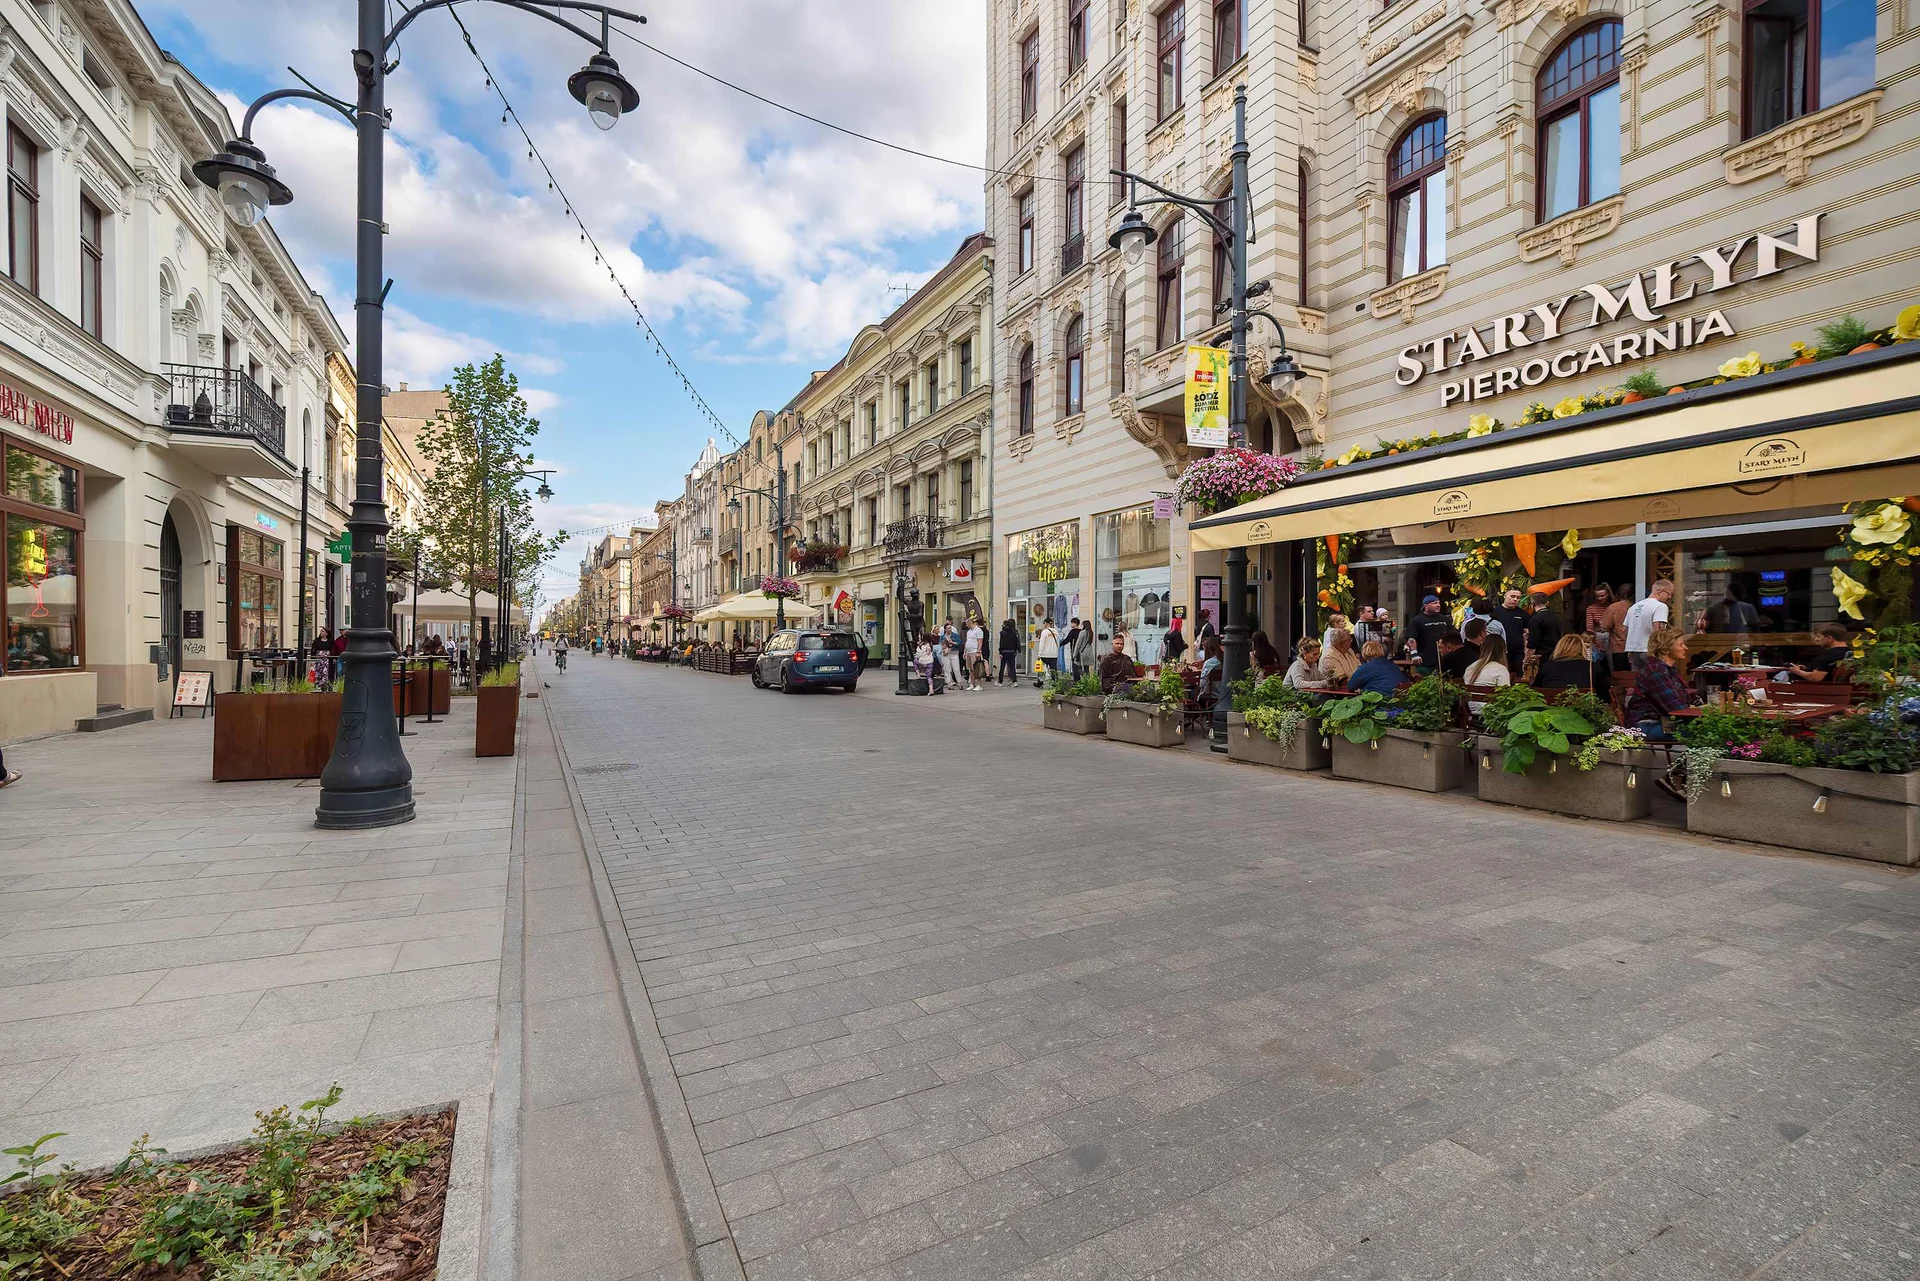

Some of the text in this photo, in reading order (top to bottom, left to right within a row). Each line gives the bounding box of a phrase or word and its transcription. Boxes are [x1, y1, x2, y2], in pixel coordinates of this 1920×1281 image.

[1395, 213, 1828, 388] STARY MŁYN
[1440, 309, 1737, 408] PIEROGARNIA
[1194, 389, 1219, 402] ŁÓDŹ
[1194, 399, 1219, 408] SUMMER
[1194, 405, 1220, 413] FESTIVAL
[1745, 460, 1771, 469] STARY
[1032, 540, 1073, 565] second
[1038, 563, 1058, 584] Life
